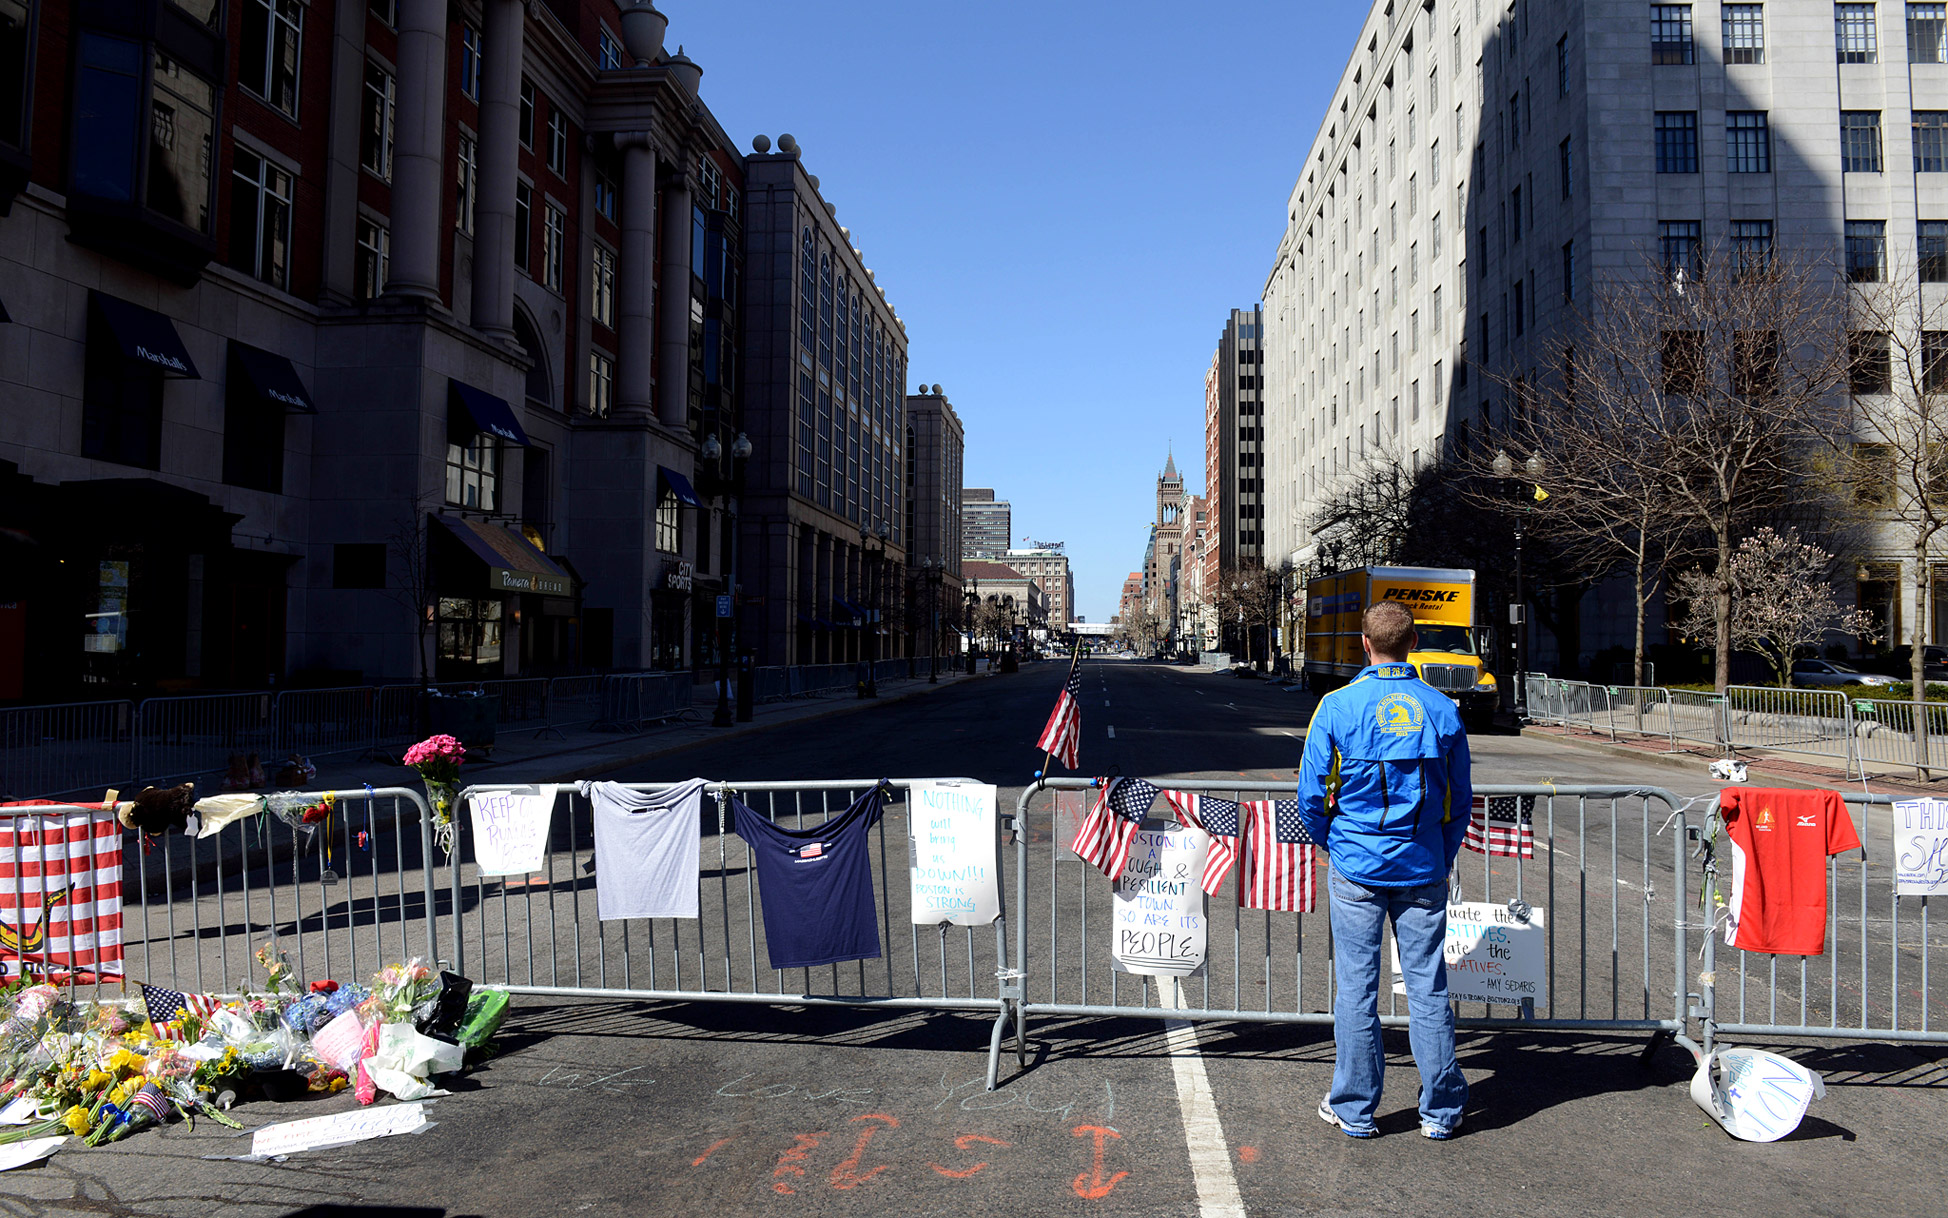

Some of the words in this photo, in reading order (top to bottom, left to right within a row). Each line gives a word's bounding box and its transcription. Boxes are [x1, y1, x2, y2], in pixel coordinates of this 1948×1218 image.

[136, 345, 188, 372] Marshalls
[268, 388, 308, 409] Marshalls
[679, 561, 694, 577] CITY
[501, 570, 530, 589] Panera
[667, 573, 693, 594] SPORTS
[1383, 588, 1460, 602] PENSKE
[1418, 602, 1443, 611] Rental
[1392, 667, 1406, 677] 26.2
[478, 794, 516, 824] KEEP
[923, 790, 985, 821] NOTHING
[930, 818, 951, 829] will
[1895, 801, 1948, 832] THI
[930, 833, 956, 852] bring
[1131, 832, 1176, 849] OSTON
[1183, 836, 1197, 850] IS
[932, 854, 946, 864] us
[1149, 848, 1157, 859] A
[915, 866, 985, 883] DOWN!!!
[1173, 862, 1190, 879] &
[915, 883, 951, 895] BOSTON
[926, 896, 976, 912] STRONG
[1117, 908, 1136, 923] SO
[1143, 913, 1170, 927] ARE
[1179, 914, 1199, 929] ITS
[1449, 907, 1482, 922] uate
[1492, 908, 1514, 925] the
[1447, 924, 1511, 944] SITIVES.
[1121, 929, 1199, 959] PEOPLE.
[1445, 941, 1471, 956] ate
[1487, 943, 1512, 961] the
[1505, 979, 1536, 993] SEDARIS
